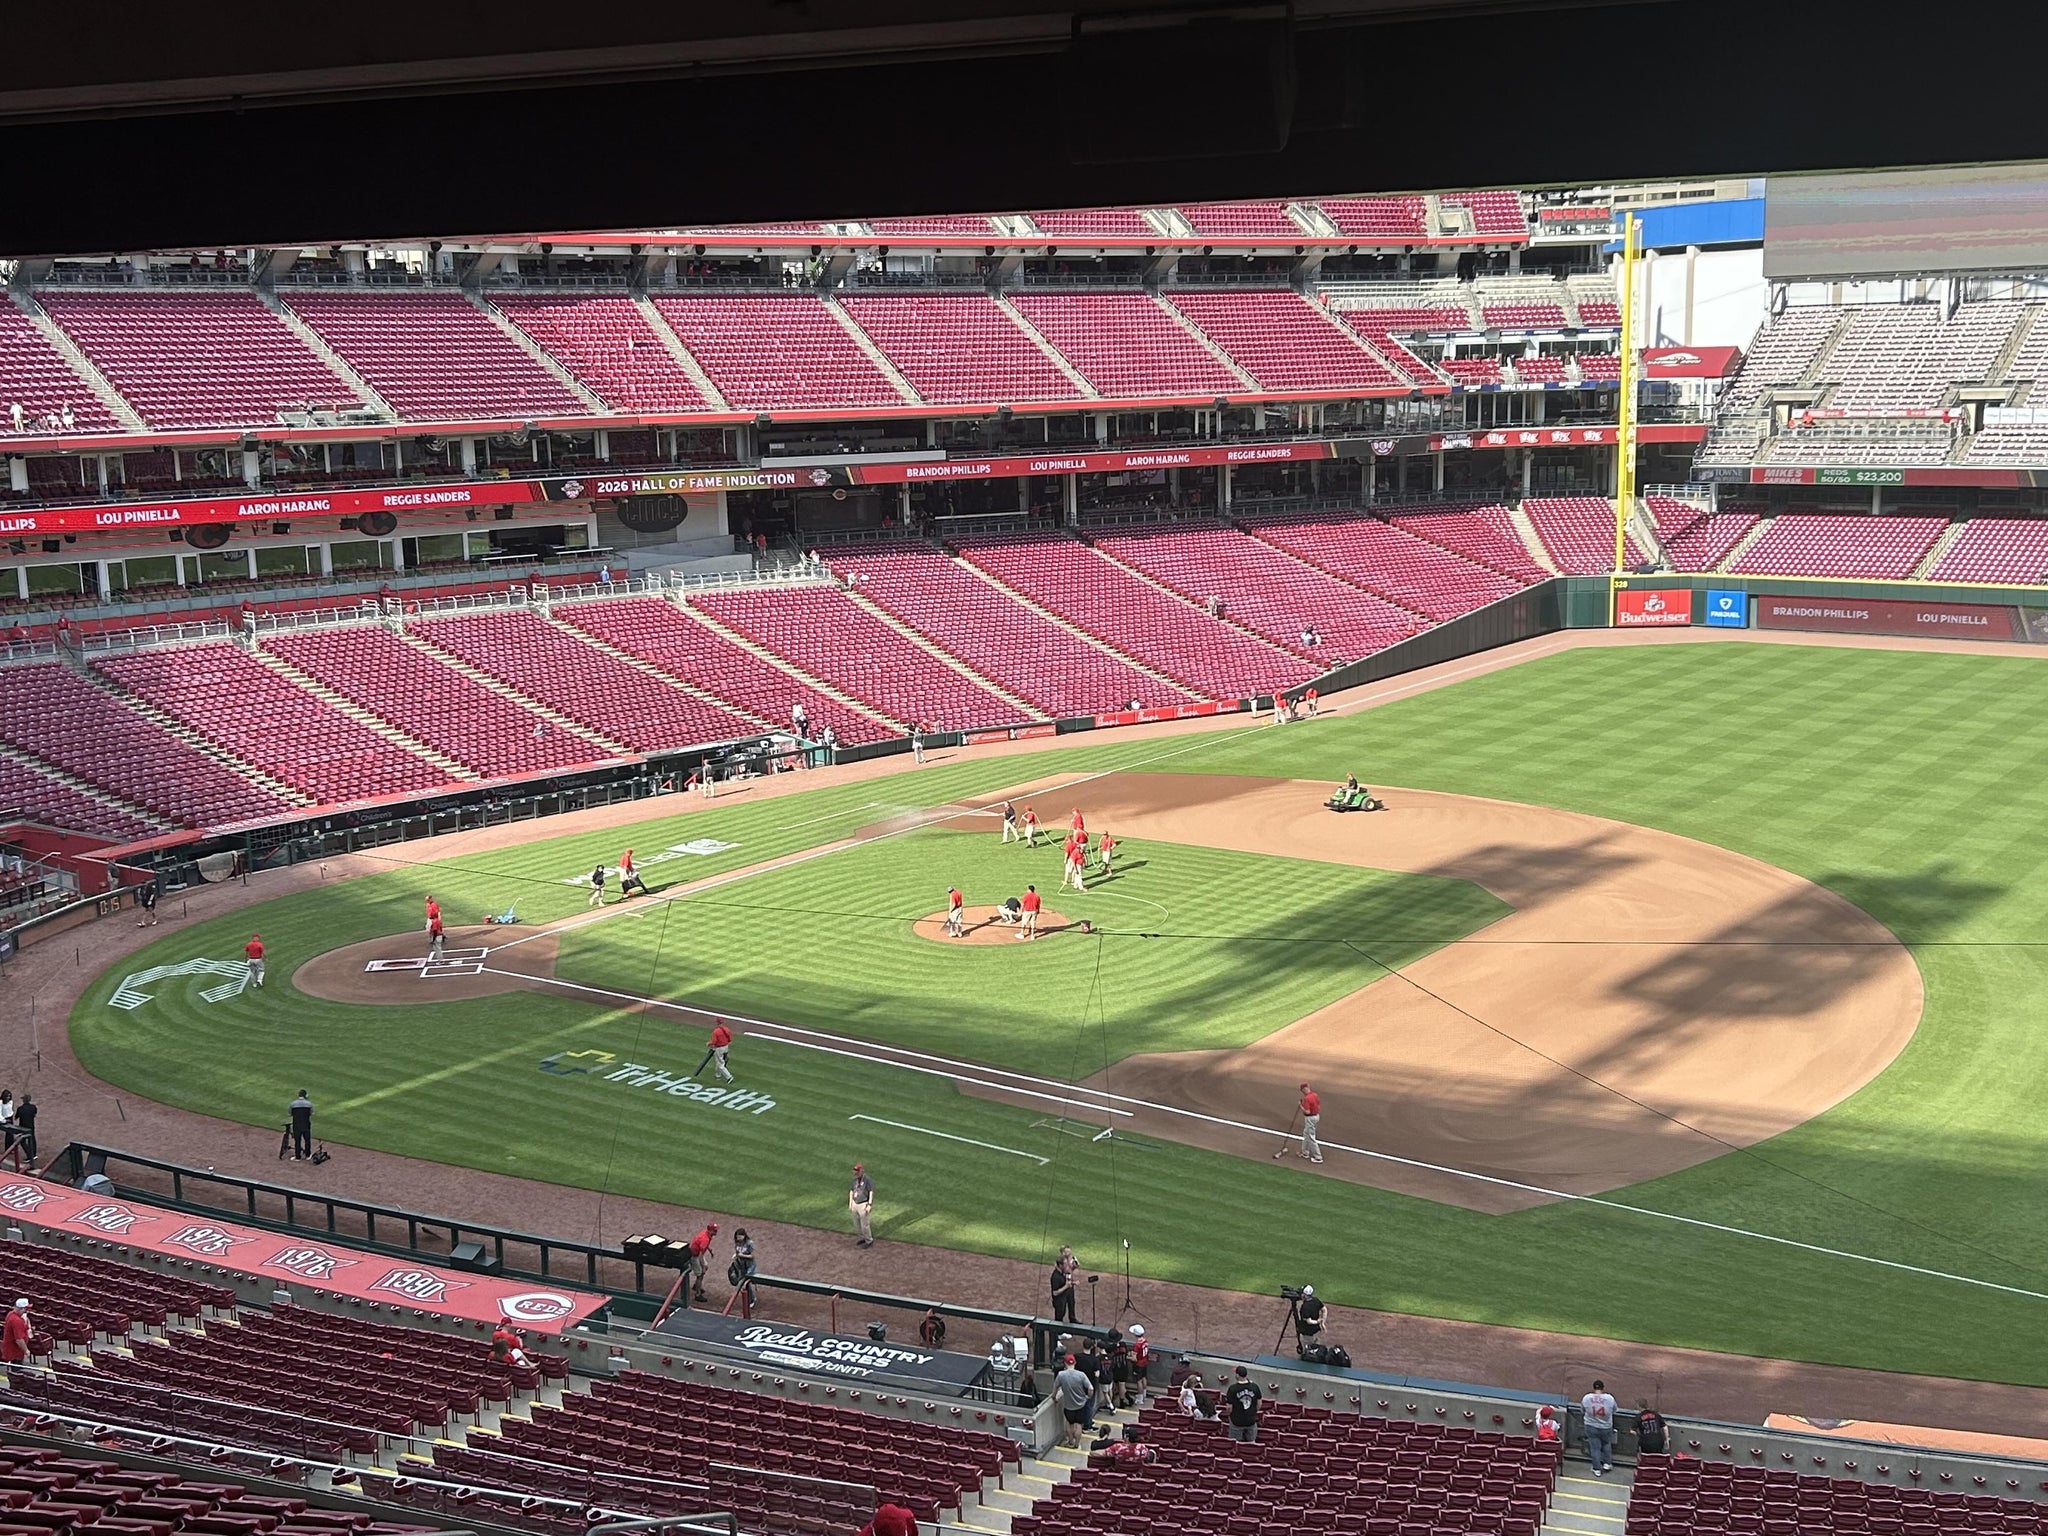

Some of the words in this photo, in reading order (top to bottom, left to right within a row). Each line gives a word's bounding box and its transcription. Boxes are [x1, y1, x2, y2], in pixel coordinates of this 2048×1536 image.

[1125, 456, 1155, 466] AARON
[1156, 454, 1190, 464] HARANG
[1227, 450, 1256, 460] REGGIE
[1257, 448, 1292, 459] SANDERS
[906, 467, 950, 478] BRANDON
[951, 464, 991, 476] PHILLIPS
[1030, 461, 1047, 471] LOU
[1049, 459, 1087, 470] PINIELLA
[1764, 469, 1804, 477] MIKES
[1856, 472, 1902, 482] $23,200
[597, 481, 629, 493] 2026
[631, 478, 665, 491] HALL
[669, 478, 687, 489] OF
[689, 476, 723, 489] FAME
[726, 473, 795, 487] INDUCTION
[383, 494, 423, 506] REGGIE
[424, 491, 471, 504] SANDERS
[238, 502, 280, 516] AARON
[281, 500, 330, 513] HARANG
[96, 512, 122, 525] LOU
[124, 508, 181, 523] PINIELLA
[1620, 612, 1688, 623] Budweiser
[1773, 606, 1822, 618] BRANDON
[1824, 609, 1869, 620] PHILLIPS
[1916, 613, 1938, 623] LOU
[1940, 614, 1988, 626] PINIELLA
[603, 1062, 777, 1115] TriHealth
[0, 1185, 45, 1209] 1919
[79, 1206, 136, 1230] 1940
[173, 1227, 233, 1252] 1975
[275, 1249, 336, 1275] 1976
[382, 1271, 446, 1298] 1990
[518, 1300, 570, 1315] REDS
[734, 1326, 815, 1354] Reds
[820, 1338, 934, 1365] COUNTRY
[812, 1347, 892, 1368] CARES
[1591, 1406, 1606, 1417] 14
